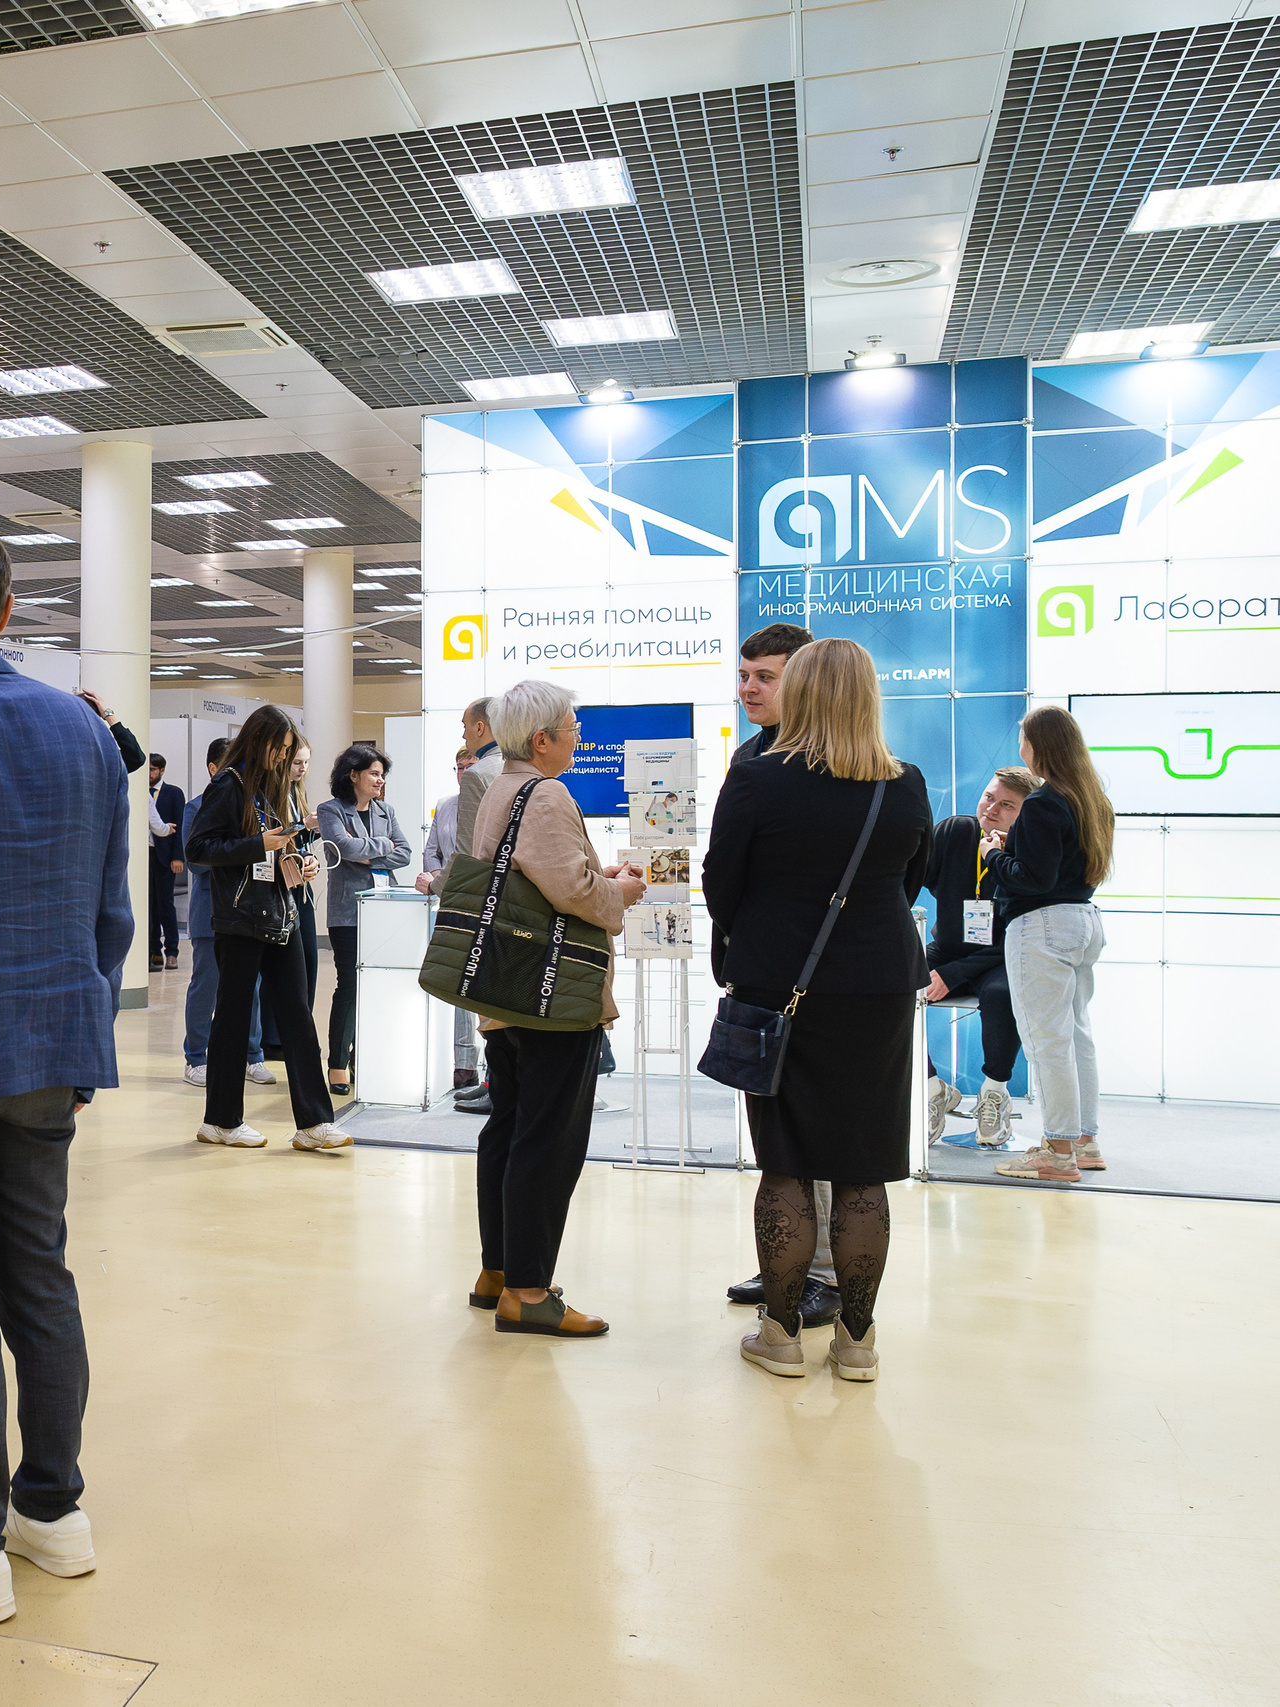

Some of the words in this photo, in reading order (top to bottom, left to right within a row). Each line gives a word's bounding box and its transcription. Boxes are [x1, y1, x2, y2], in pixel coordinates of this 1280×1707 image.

[758, 563, 1012, 600] МЕДИЦИНСКАЯ
[758, 597, 922, 617] ИНФОРМАЦИОННАЯ
[930, 594, 1012, 611] СИСТЕМА
[503, 607, 594, 628] Ранняя
[604, 606, 712, 625] помощь
[503, 645, 516, 660] и
[526, 638, 722, 665] реабилитация
[892, 668, 951, 681] СП.АРМ
[460, 979, 470, 997] SPORT
[476, 928, 486, 945] SPORT
[491, 876, 500, 894] SPORT
[551, 947, 559, 964] SPORT
[539, 998, 548, 1017] SPORT
